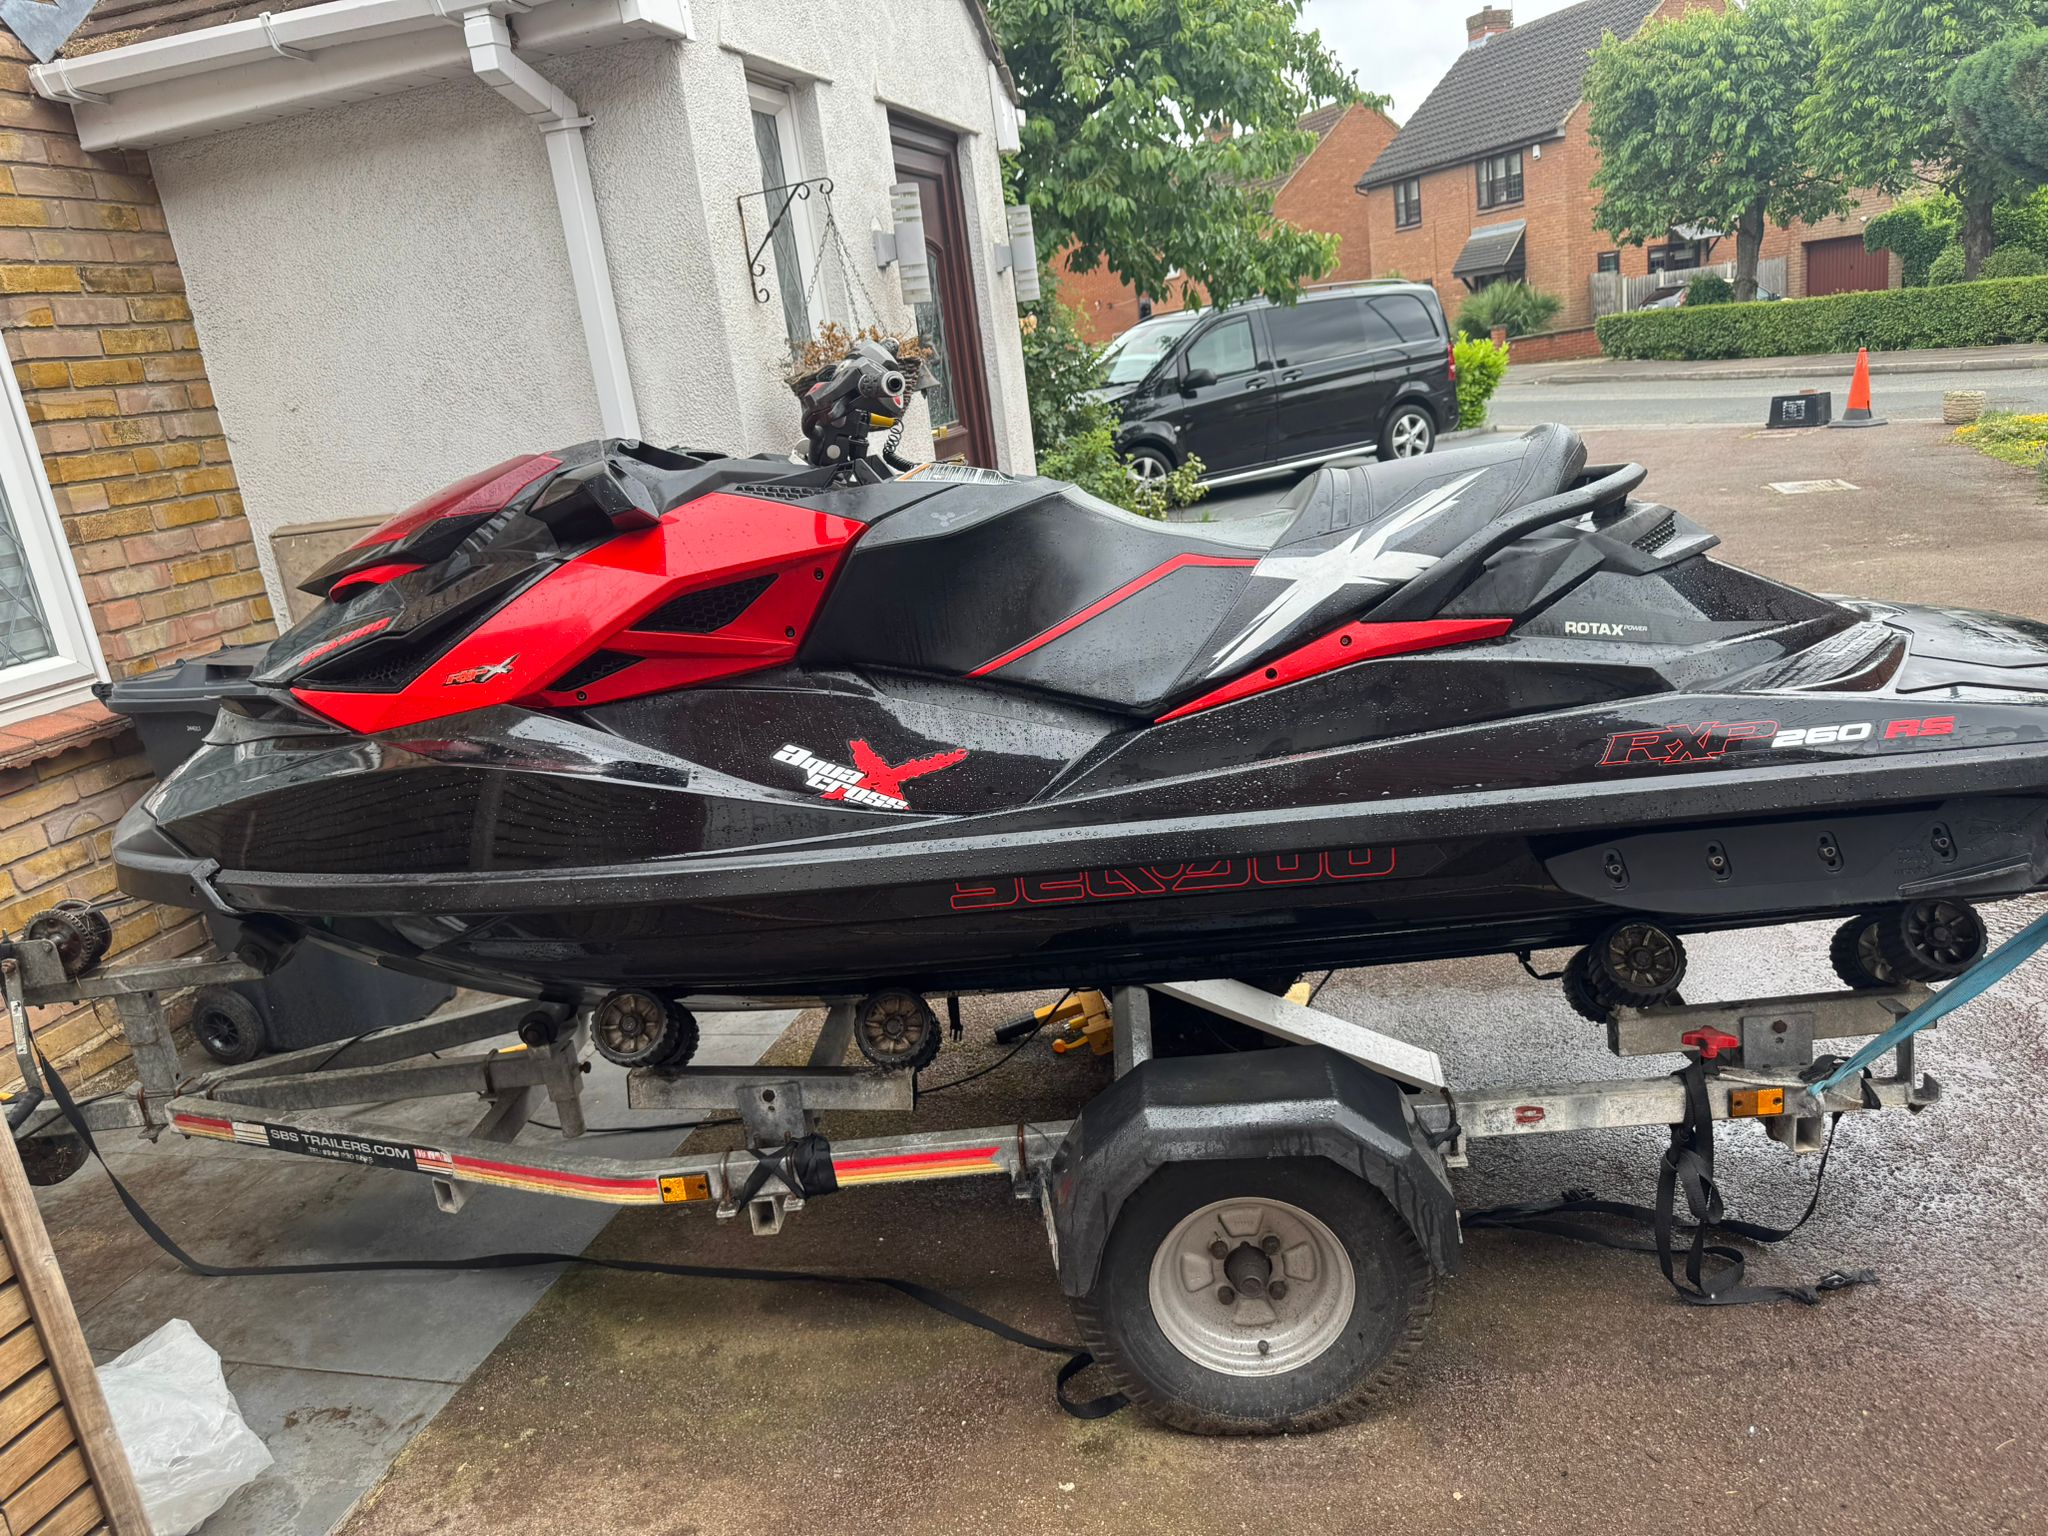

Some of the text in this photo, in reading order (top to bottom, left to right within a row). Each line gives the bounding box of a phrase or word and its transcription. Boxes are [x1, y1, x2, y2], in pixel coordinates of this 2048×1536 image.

[1564, 621, 1648, 636] ROTAX POWER
[1771, 722, 1873, 748] 260
[1884, 716, 1956, 740] RS
[270, 1129, 299, 1142] SBS
[301, 1133, 411, 1160] TRAILERS.COM
